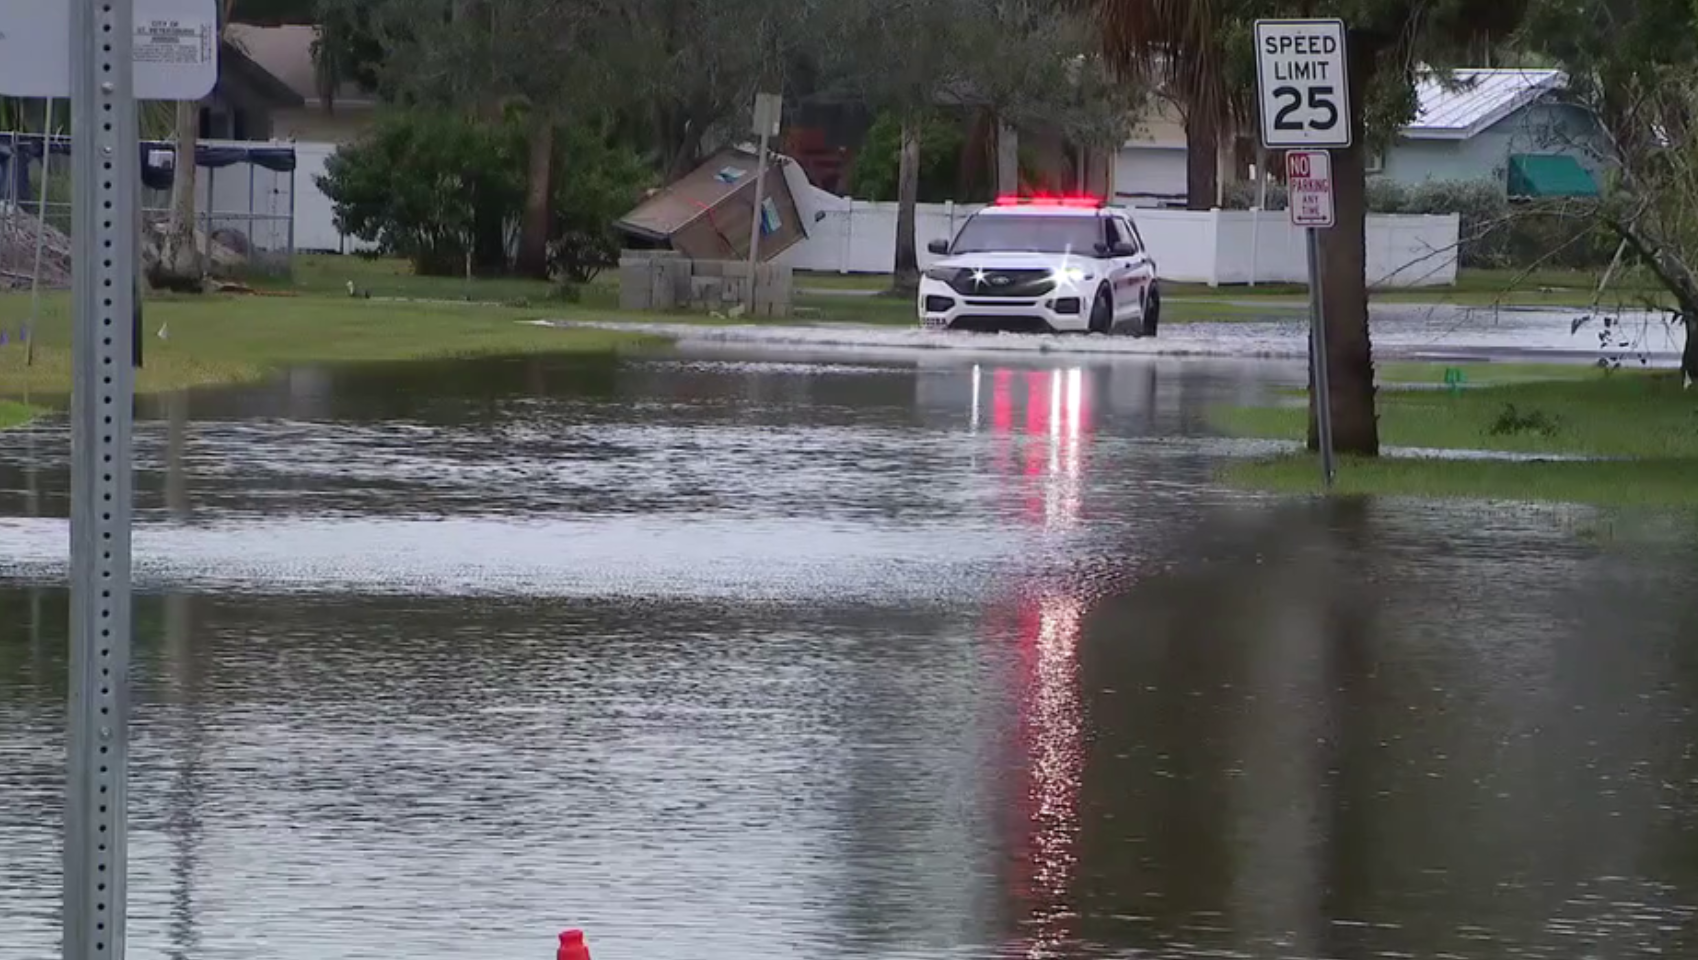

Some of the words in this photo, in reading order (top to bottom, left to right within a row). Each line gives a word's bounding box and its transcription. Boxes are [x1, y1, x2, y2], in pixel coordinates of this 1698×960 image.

[1265, 35, 1336, 54] SPEED
[1274, 60, 1329, 80] LIMIT
[1272, 86, 1338, 130] 25
[1290, 155, 1309, 175] NO
[1291, 178, 1329, 193] PARKING
[1303, 195, 1319, 204] ANY
[1302, 205, 1320, 216] TIME
